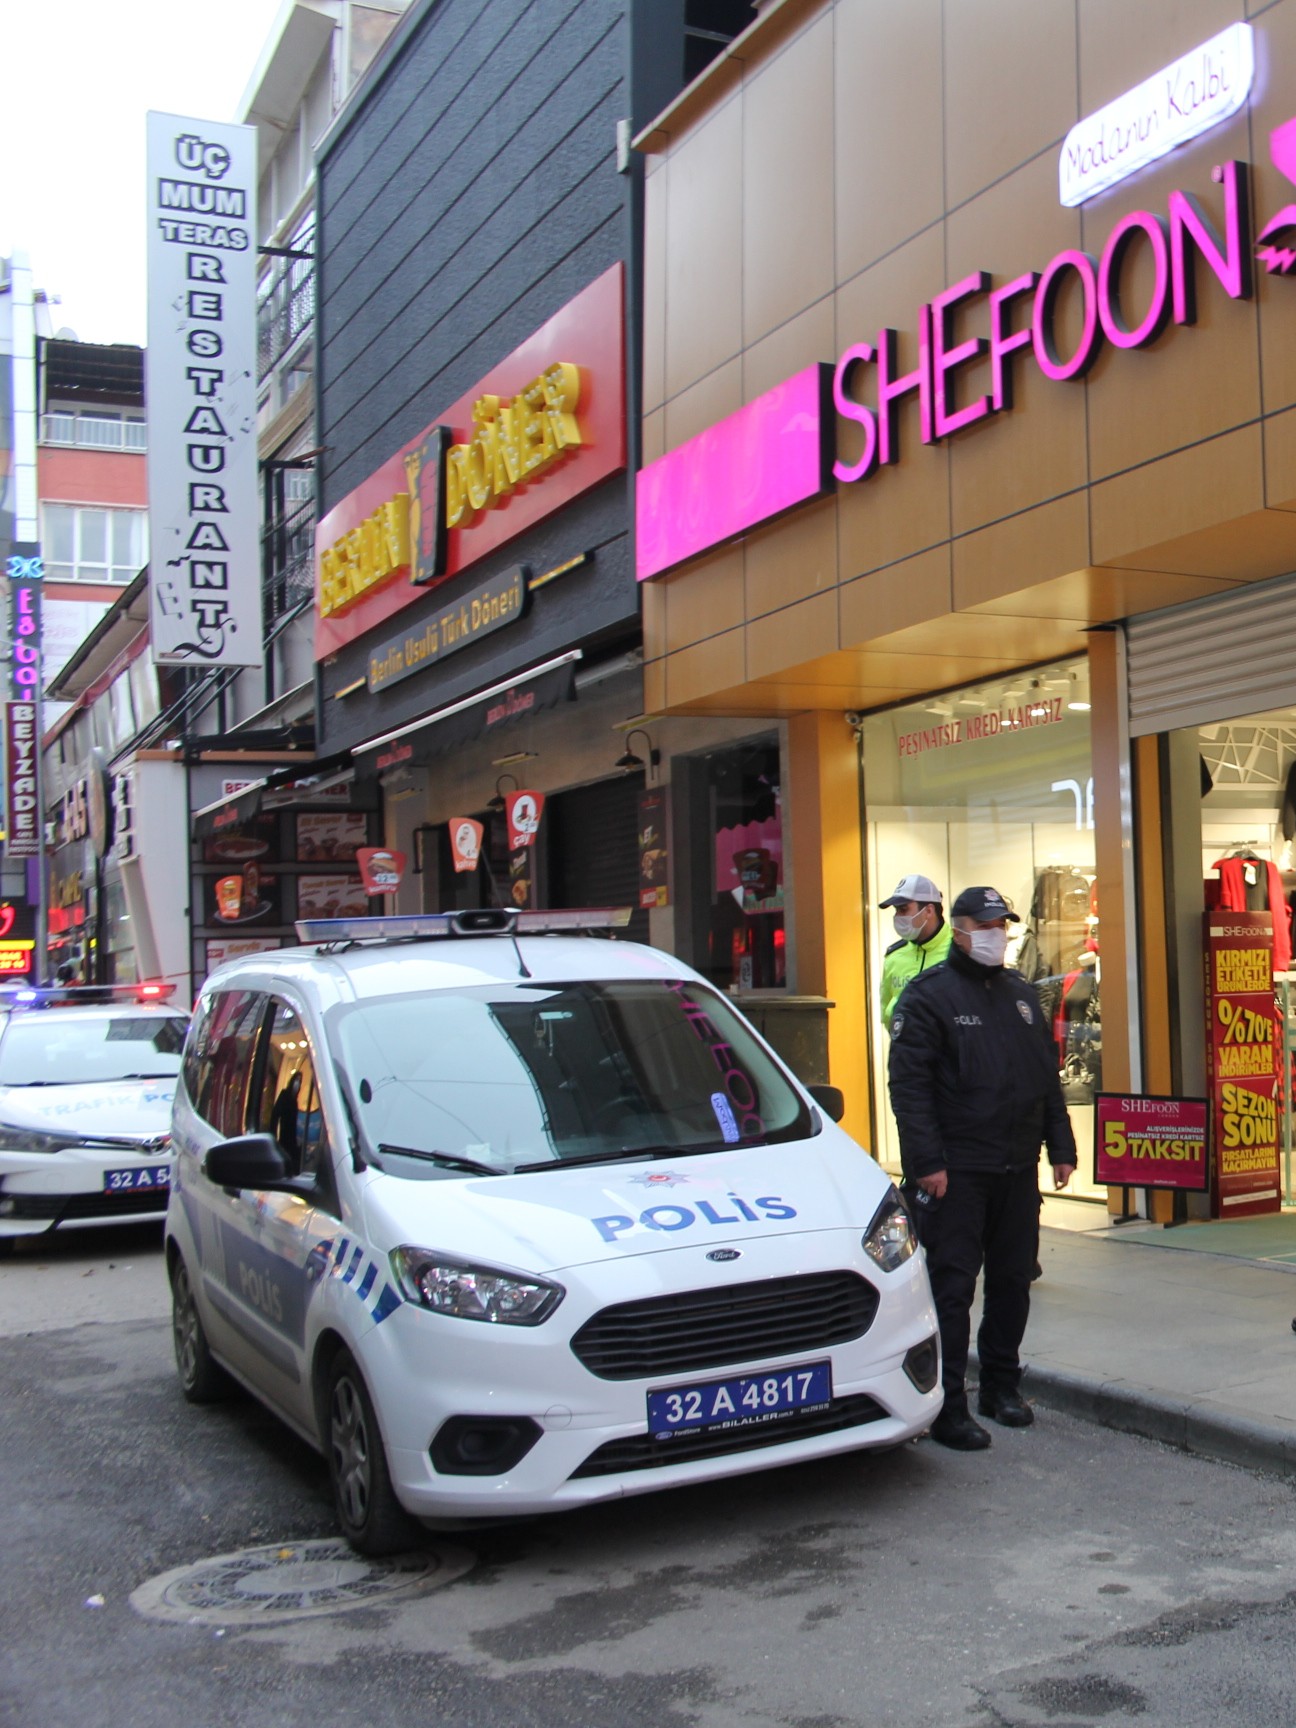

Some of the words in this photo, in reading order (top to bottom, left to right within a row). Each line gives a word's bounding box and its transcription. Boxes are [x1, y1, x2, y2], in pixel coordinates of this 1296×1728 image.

[1166, 50, 1229, 119] Kalbi
[176, 134, 231, 180] ÜÇ
[158, 177, 246, 219] MUM
[158, 218, 248, 250] TERAS
[832, 160, 1254, 484] SHEFOON
[183, 252, 231, 628] RESTAURANT
[370, 647, 404, 687] Berlin
[440, 605, 470, 647] Türk
[471, 576, 519, 632] Döneri
[12, 705, 36, 830] BEYZADE
[1215, 949, 1270, 967] KIRMIZI
[1218, 1044, 1273, 1065] VARAN
[1121, 1099, 1180, 1113] SHEFOON
[1221, 1082, 1276, 1119] SEZON
[1104, 1121, 1127, 1158] 5
[1127, 1138, 1205, 1161] TAKSİT
[1222, 1112, 1277, 1147] SONU
[111, 1172, 133, 1188] 32
[137, 1170, 152, 1186] A
[157, 1168, 171, 1183] 5
[591, 1192, 798, 1243] POLİS
[665, 1391, 703, 1423] 32
[711, 1387, 736, 1416] A
[742, 1372, 814, 1410] 4817
